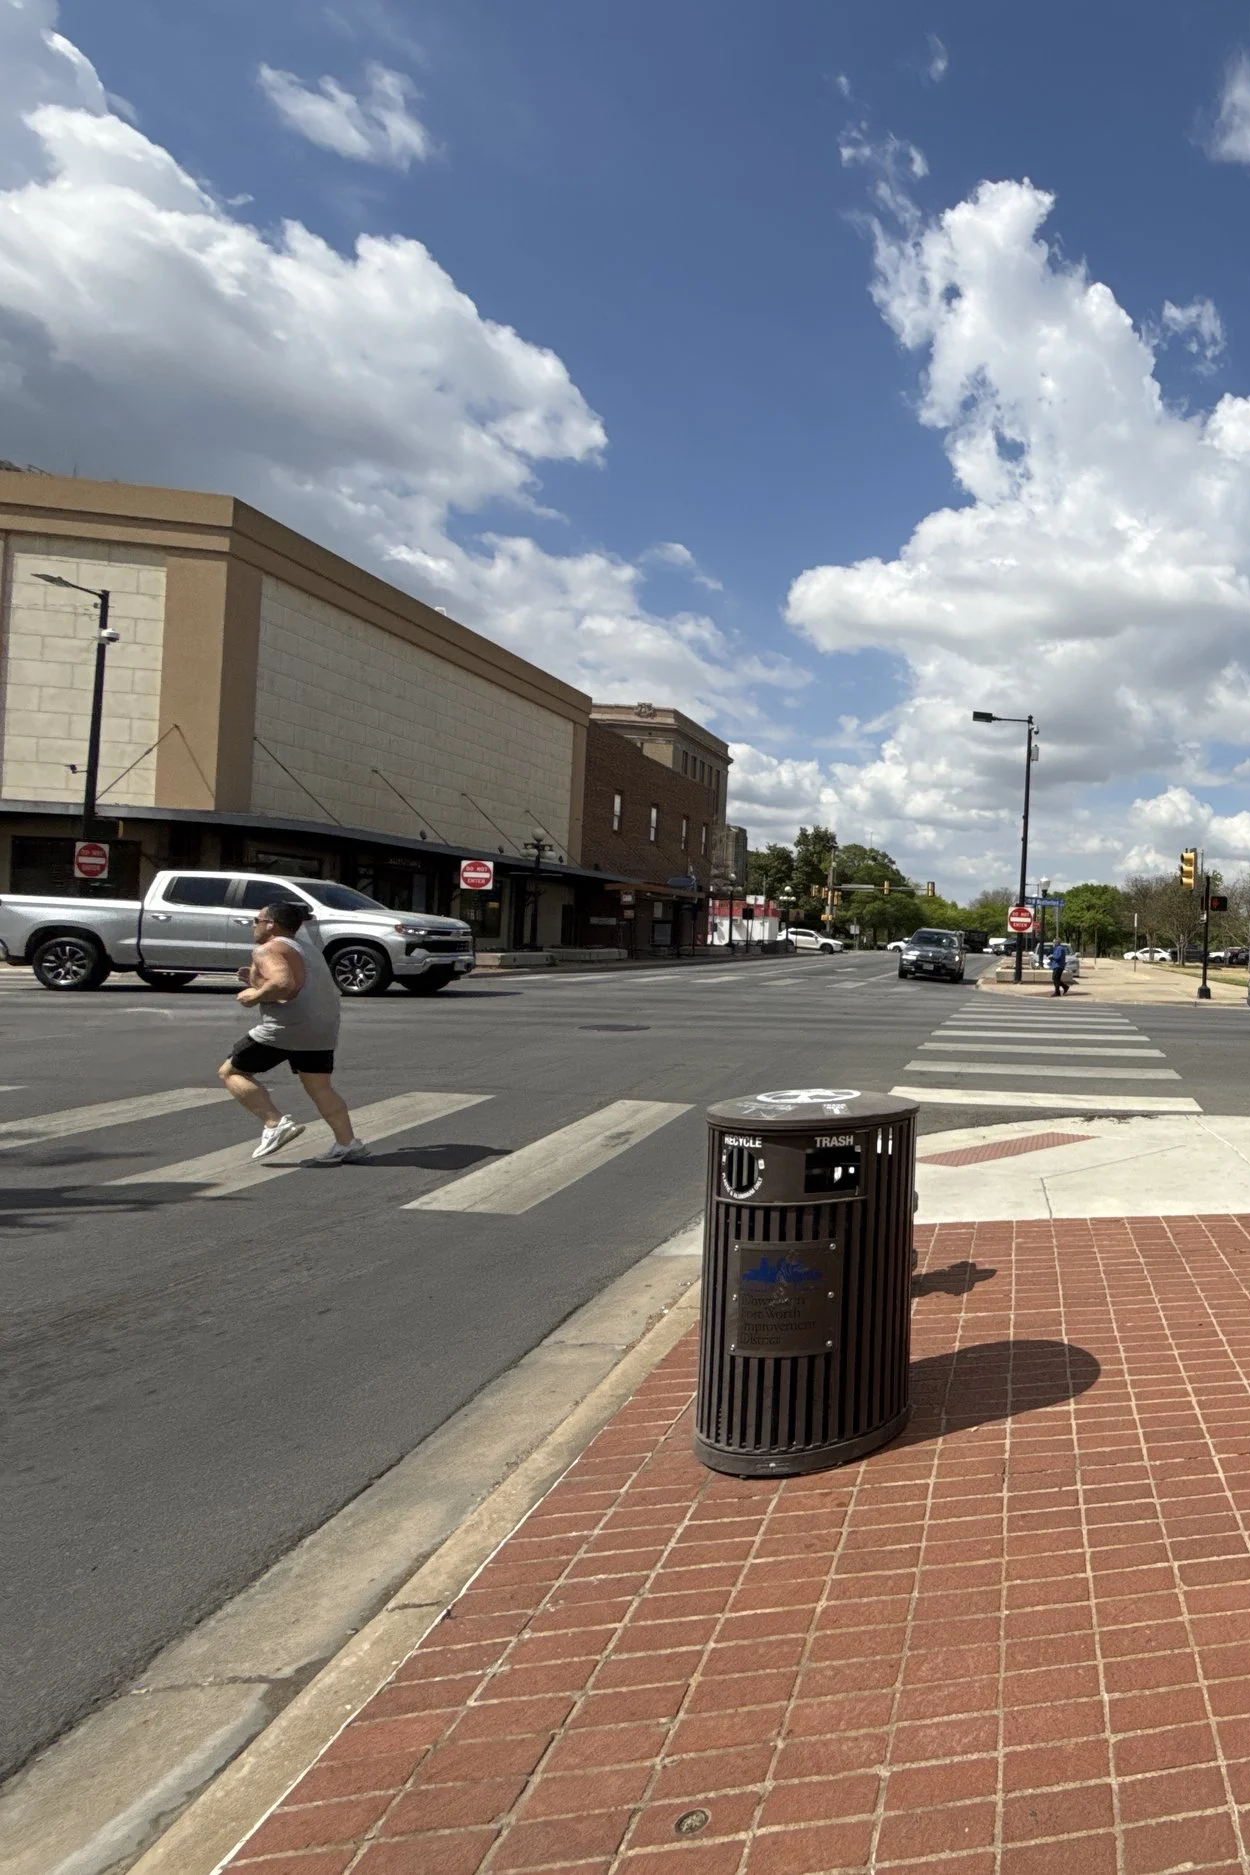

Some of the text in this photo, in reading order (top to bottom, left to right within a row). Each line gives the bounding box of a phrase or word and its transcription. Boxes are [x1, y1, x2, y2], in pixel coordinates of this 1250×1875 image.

[724, 1134, 762, 1148] RECYCLE
[815, 1135, 853, 1148] TRASH
[764, 1307, 801, 1320] Worth
